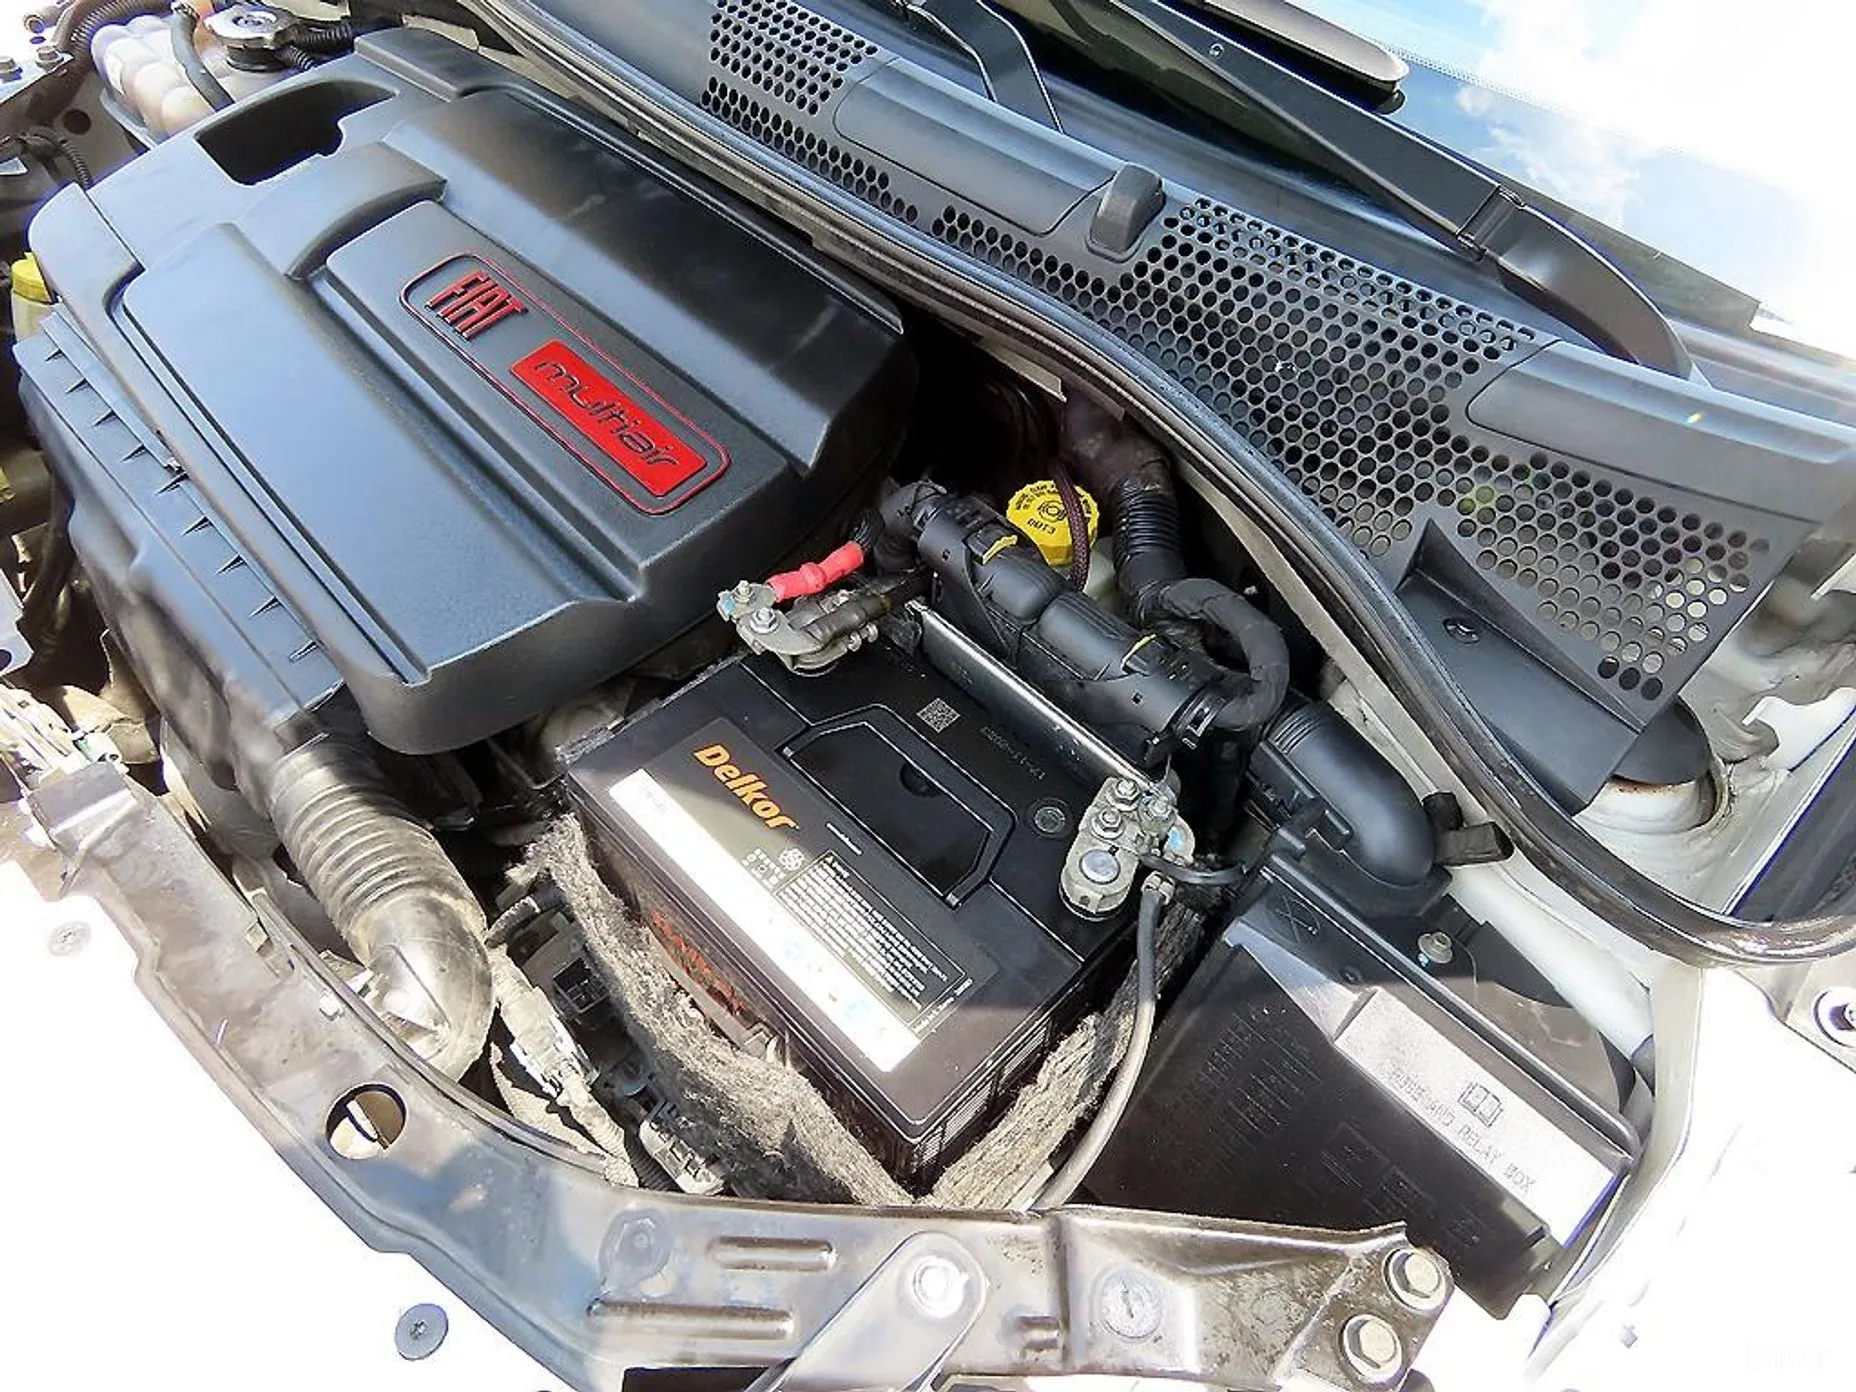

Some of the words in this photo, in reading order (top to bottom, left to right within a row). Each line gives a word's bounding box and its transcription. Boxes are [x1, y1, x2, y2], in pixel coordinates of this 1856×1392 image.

[425, 269, 527, 340] FIAT
[535, 360, 680, 467] multiair
[694, 744, 796, 829] Delkor
[1425, 1097, 1457, 1128] AND
[1455, 1123, 1502, 1165] RELAY
[1502, 1162, 1536, 1194] BOX
